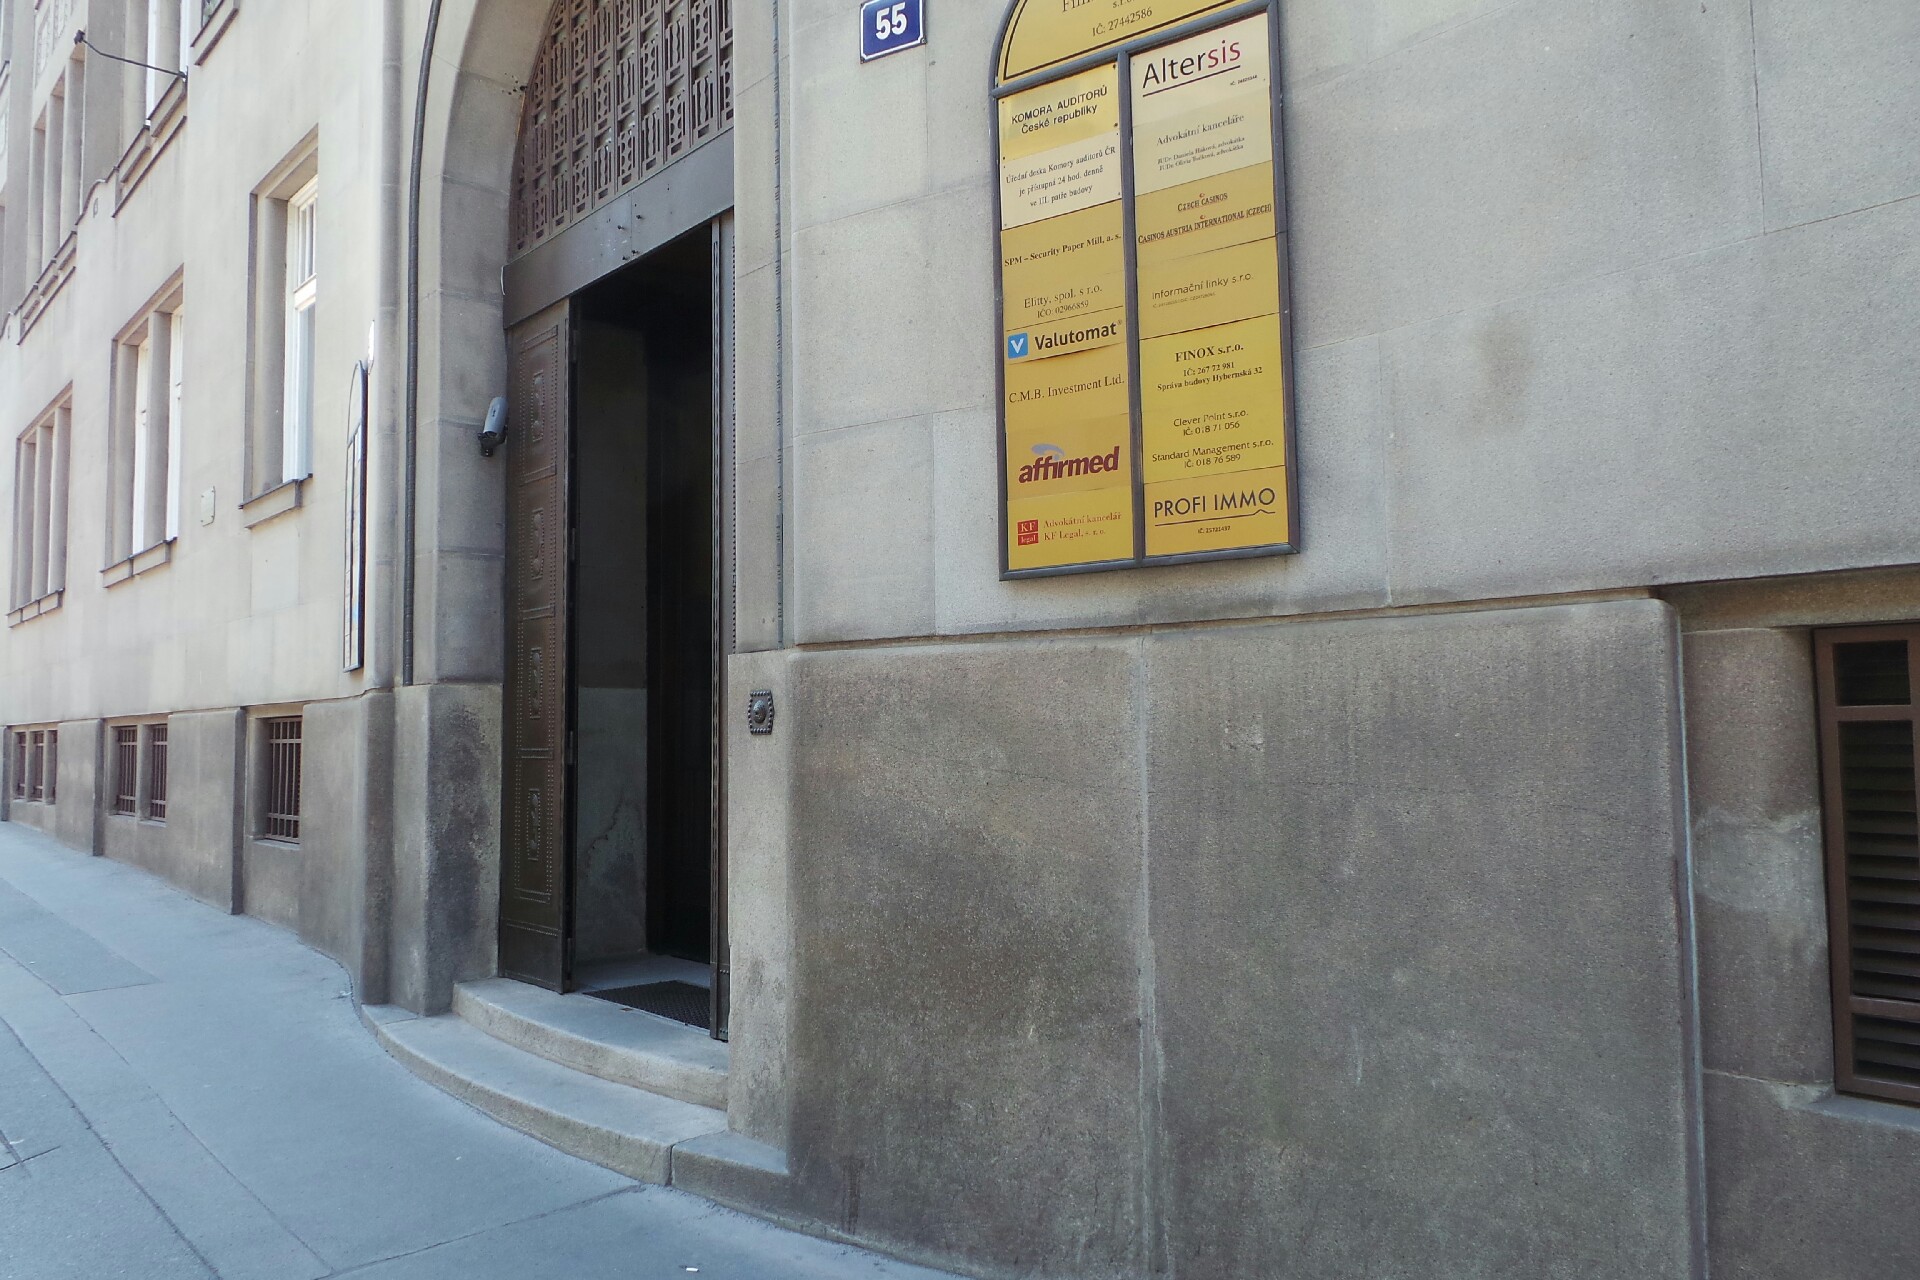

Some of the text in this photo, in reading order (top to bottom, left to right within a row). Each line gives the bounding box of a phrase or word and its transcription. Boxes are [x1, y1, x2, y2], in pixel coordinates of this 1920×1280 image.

[876, 2, 907, 40] 55
[1092, 7, 1152, 36] IČ: 27442586
[1142, 40, 1241, 88] Altersis
[1012, 85, 1107, 124] KOMORA AUDITORŮ
[1021, 105, 1097, 134] České republiky
[1157, 114, 1244, 146] Advokátní kanceláře
[1029, 167, 1047, 177] deska
[1048, 159, 1073, 172] Komory
[1076, 149, 1102, 164] auditorů
[1105, 146, 1116, 156] ČR
[1019, 165, 1104, 197] je přístupná 24 hod. denně
[1051, 191, 1067, 203] patře
[1069, 185, 1092, 197] budovy
[1177, 193, 1228, 212] CZECH CASINOS
[1138, 203, 1272, 244] CASINOS AUSTRIA INTERNATIONAL (CZECH)
[1004, 256, 1022, 267] SPM
[1030, 247, 1060, 260] Security
[1062, 242, 1084, 253] Paper
[1086, 235, 1105, 247] Mill,
[1054, 288, 1076, 303] spol.
[1087, 284, 1102, 294] r.o.
[1206, 278, 1228, 289] linky
[1037, 308, 1053, 319] IČO:
[1034, 322, 1117, 351] Valutomat
[1175, 344, 1244, 362] FINOX s.r.o.
[1157, 366, 1263, 392] Správa budovy Hybernská 32
[1183, 368, 1196, 377] IČ:
[1197, 366, 1210, 375] 267
[1009, 374, 1125, 403] C.M.B. Investment Ltd.
[1173, 410, 1249, 427] Clever Point s.r.o.
[1183, 421, 1240, 436] IČ: 018 71 056
[1152, 439, 1274, 462] Standard Management s.r.o.
[1184, 453, 1241, 468] IČ: 018 76 589
[1018, 445, 1120, 484] affirmed
[1154, 488, 1275, 518] PROFI IMMO
[1021, 522, 1036, 532] KF
[1044, 512, 1122, 528] Advokátní kancelář
[1020, 534, 1036, 545] legal
[1044, 532, 1057, 541] KF
[1059, 528, 1084, 539] Legal,
